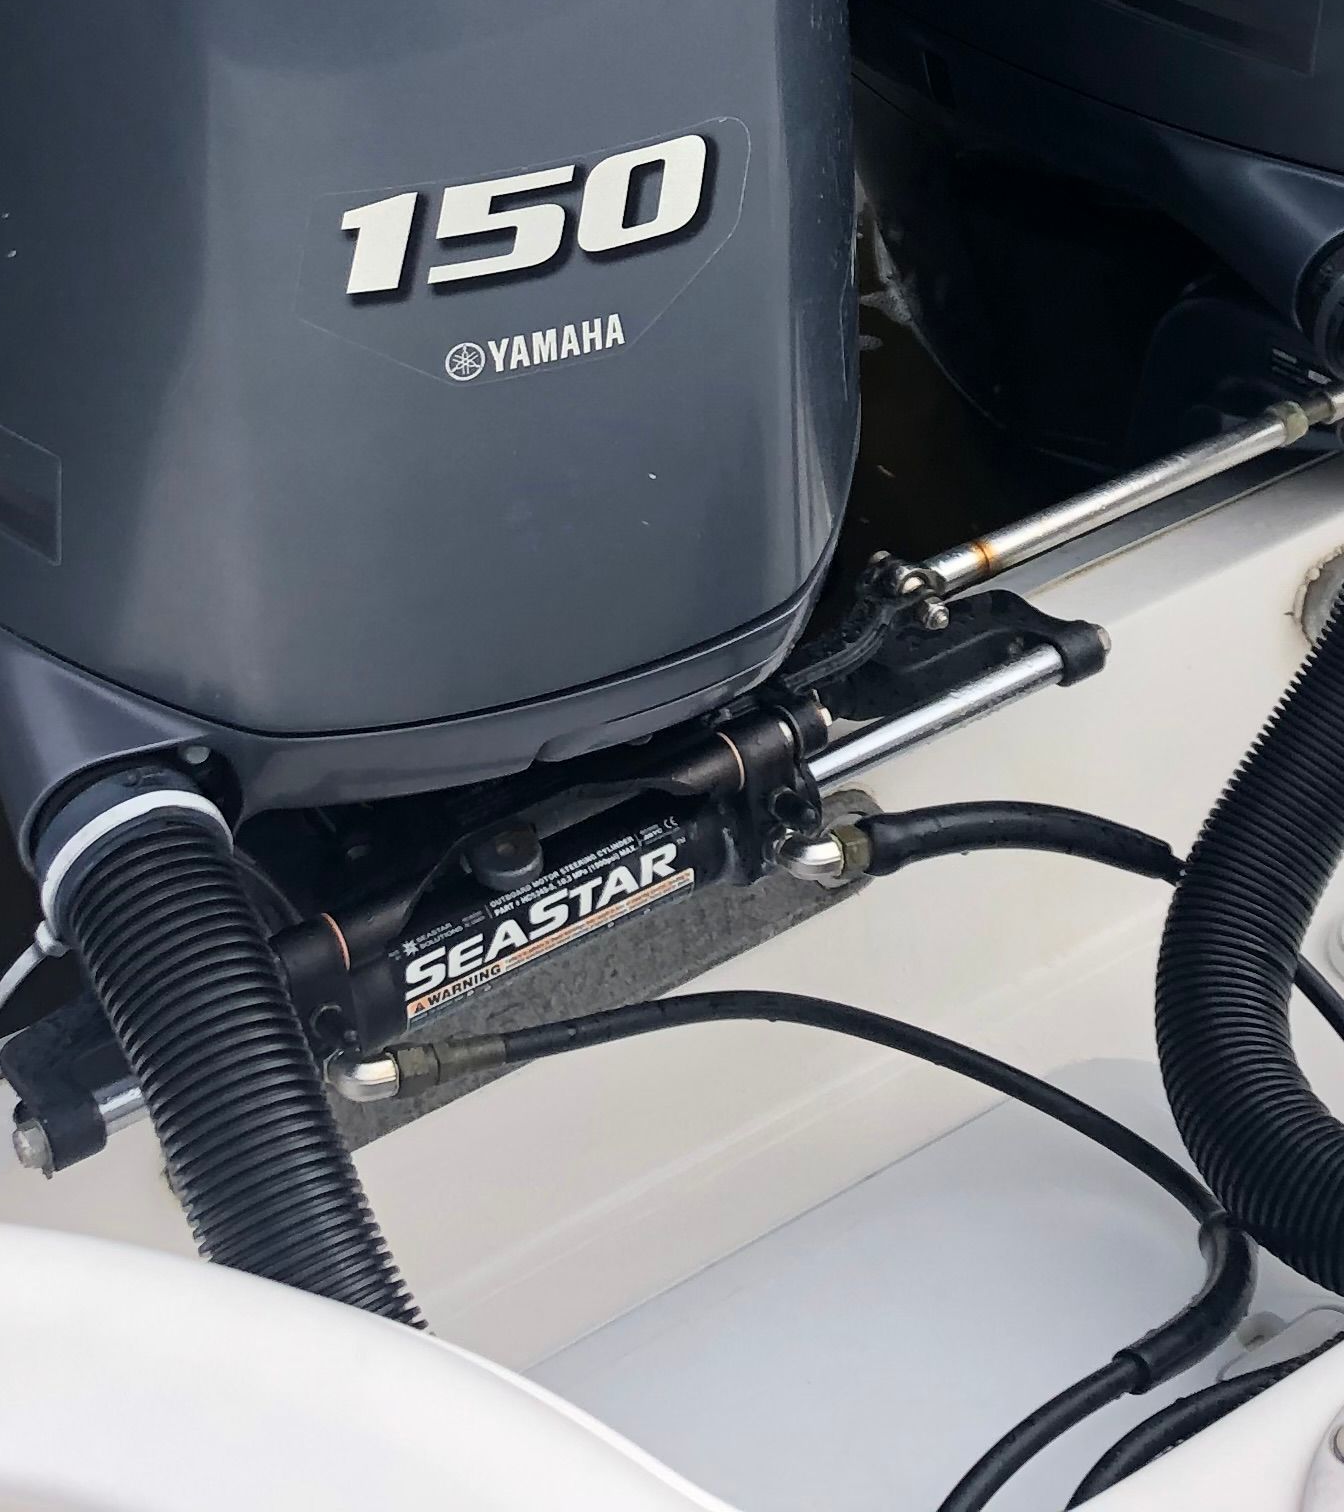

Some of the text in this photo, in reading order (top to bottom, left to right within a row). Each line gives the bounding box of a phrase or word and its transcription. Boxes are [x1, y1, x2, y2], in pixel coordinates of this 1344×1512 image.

[341, 133, 712, 299] 150
[487, 312, 627, 373] YAMAHA
[489, 883, 532, 908] OUTBOARD
[531, 870, 560, 888] MOTOR
[596, 835, 635, 858] CYLINDER
[404, 842, 678, 1002] SEASTAR
[416, 922, 453, 943] SEASTAR
[494, 901, 515, 917] PART
[419, 925, 464, 950] SOLUTIONS
[427, 964, 502, 1007] WARNING
